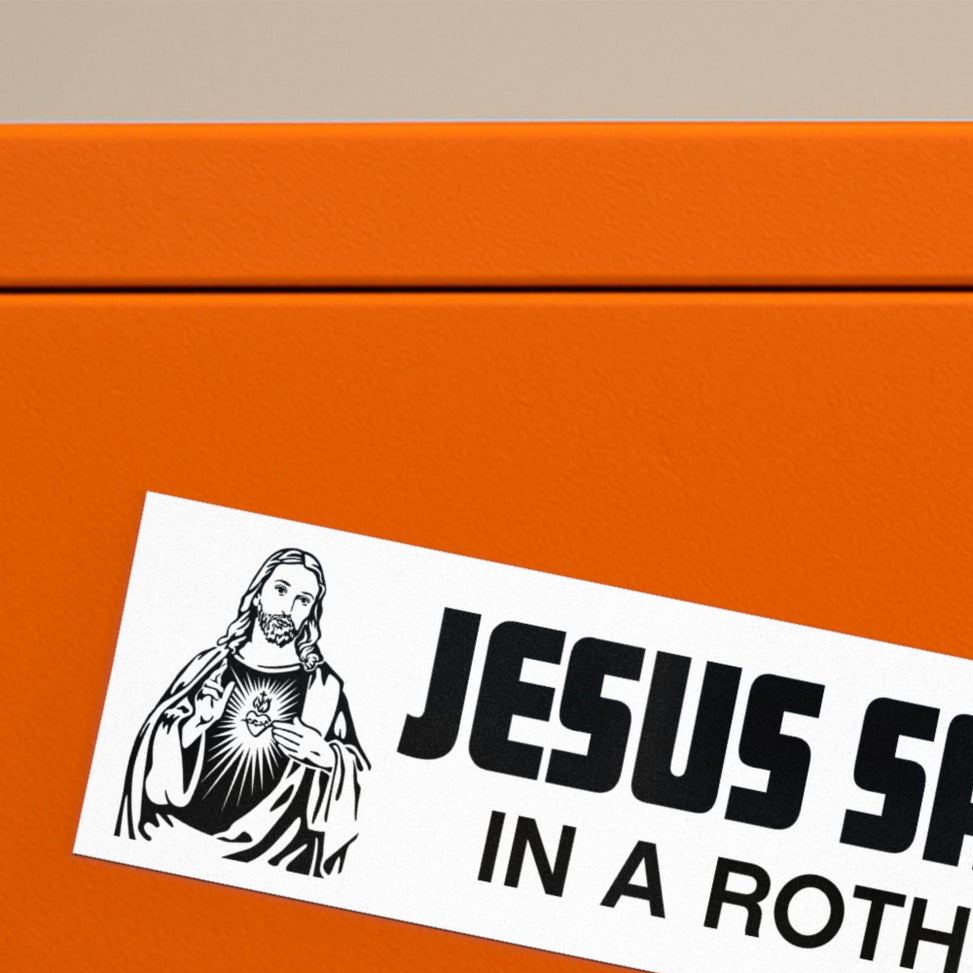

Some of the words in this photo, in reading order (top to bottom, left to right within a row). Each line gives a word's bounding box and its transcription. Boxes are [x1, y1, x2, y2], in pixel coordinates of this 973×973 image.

[397, 607, 825, 829] JESUS
[478, 811, 576, 897] IN
[600, 841, 665, 918] A
